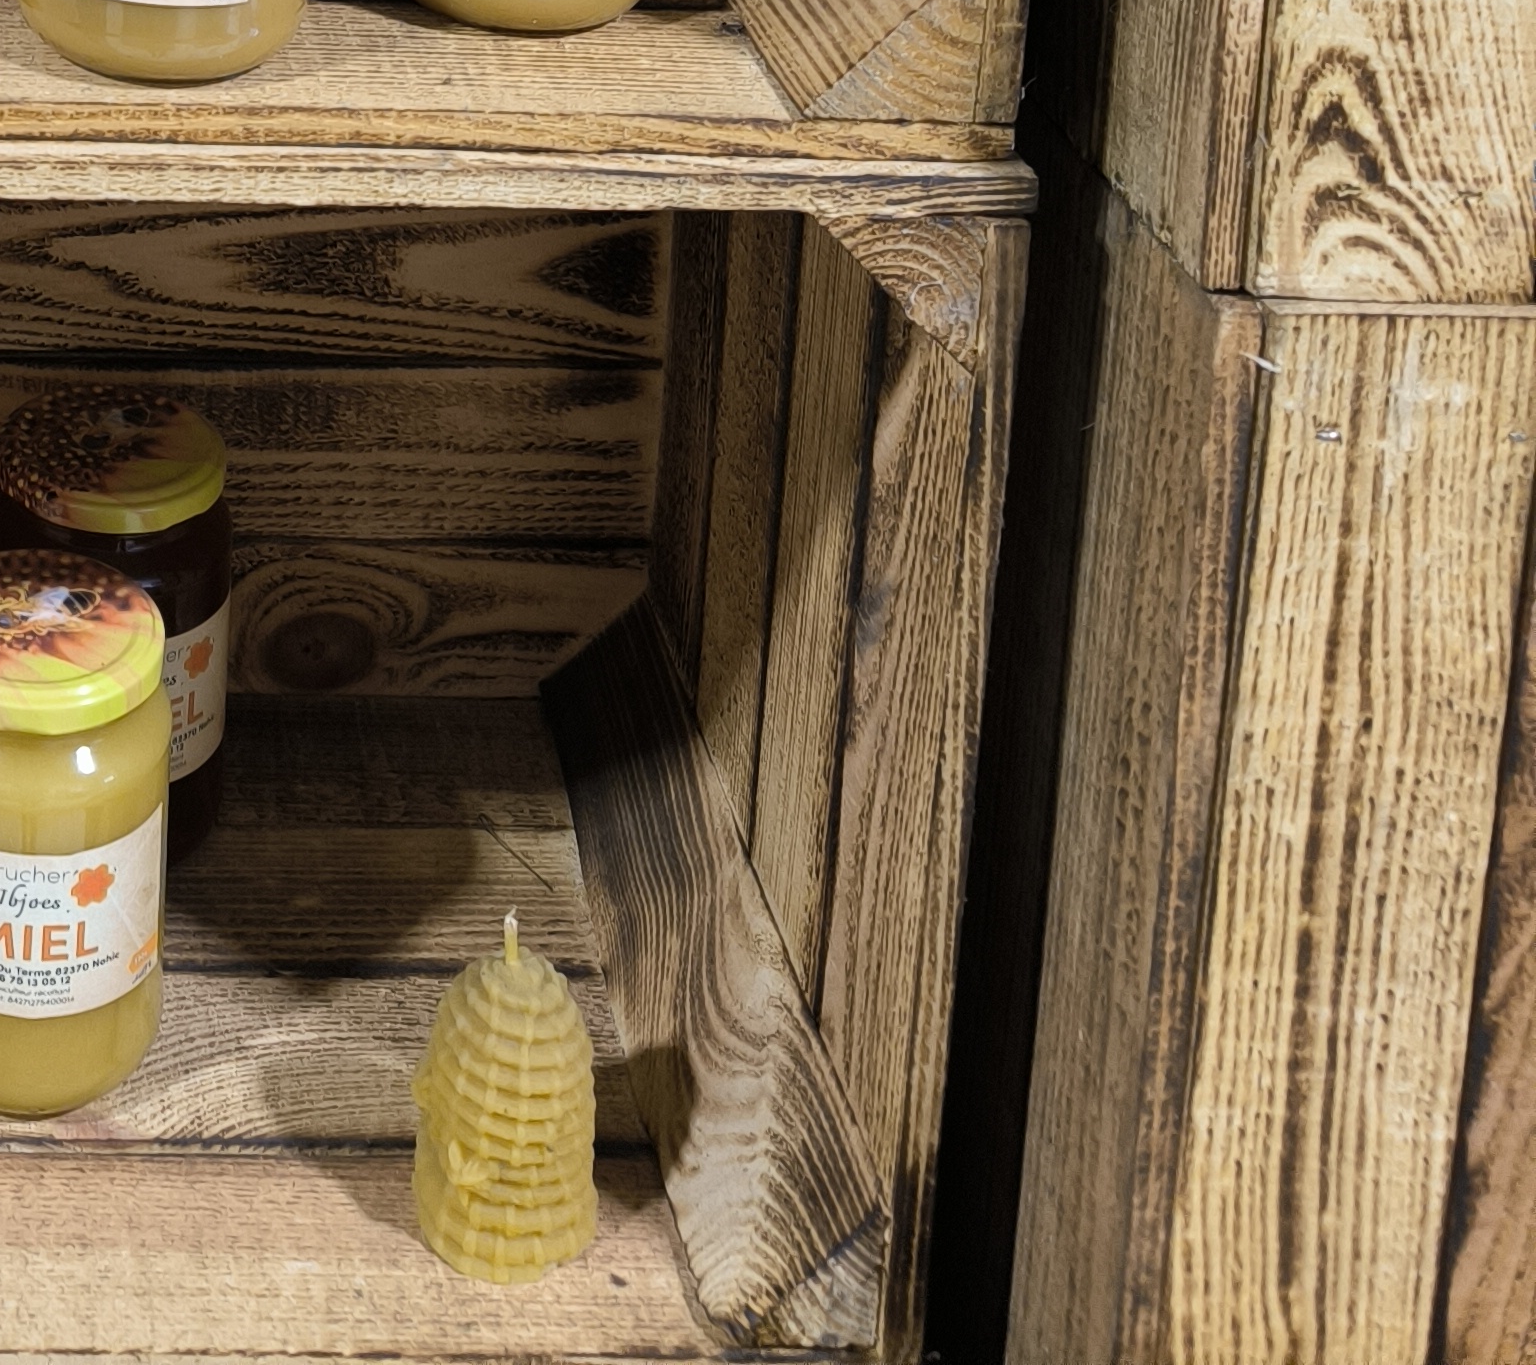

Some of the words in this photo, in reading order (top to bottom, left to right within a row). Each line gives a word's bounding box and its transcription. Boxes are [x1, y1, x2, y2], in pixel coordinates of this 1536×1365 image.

[170, 690, 204, 732] EL
[15, 966, 51, 977] Terme
[55, 963, 89, 976] 82370
[93, 951, 120, 968] Nohic
[10, 975, 24, 985] 75
[28, 978, 38, 987] 13
[42, 977, 56, 986] 05
[61, 976, 71, 985] 12
